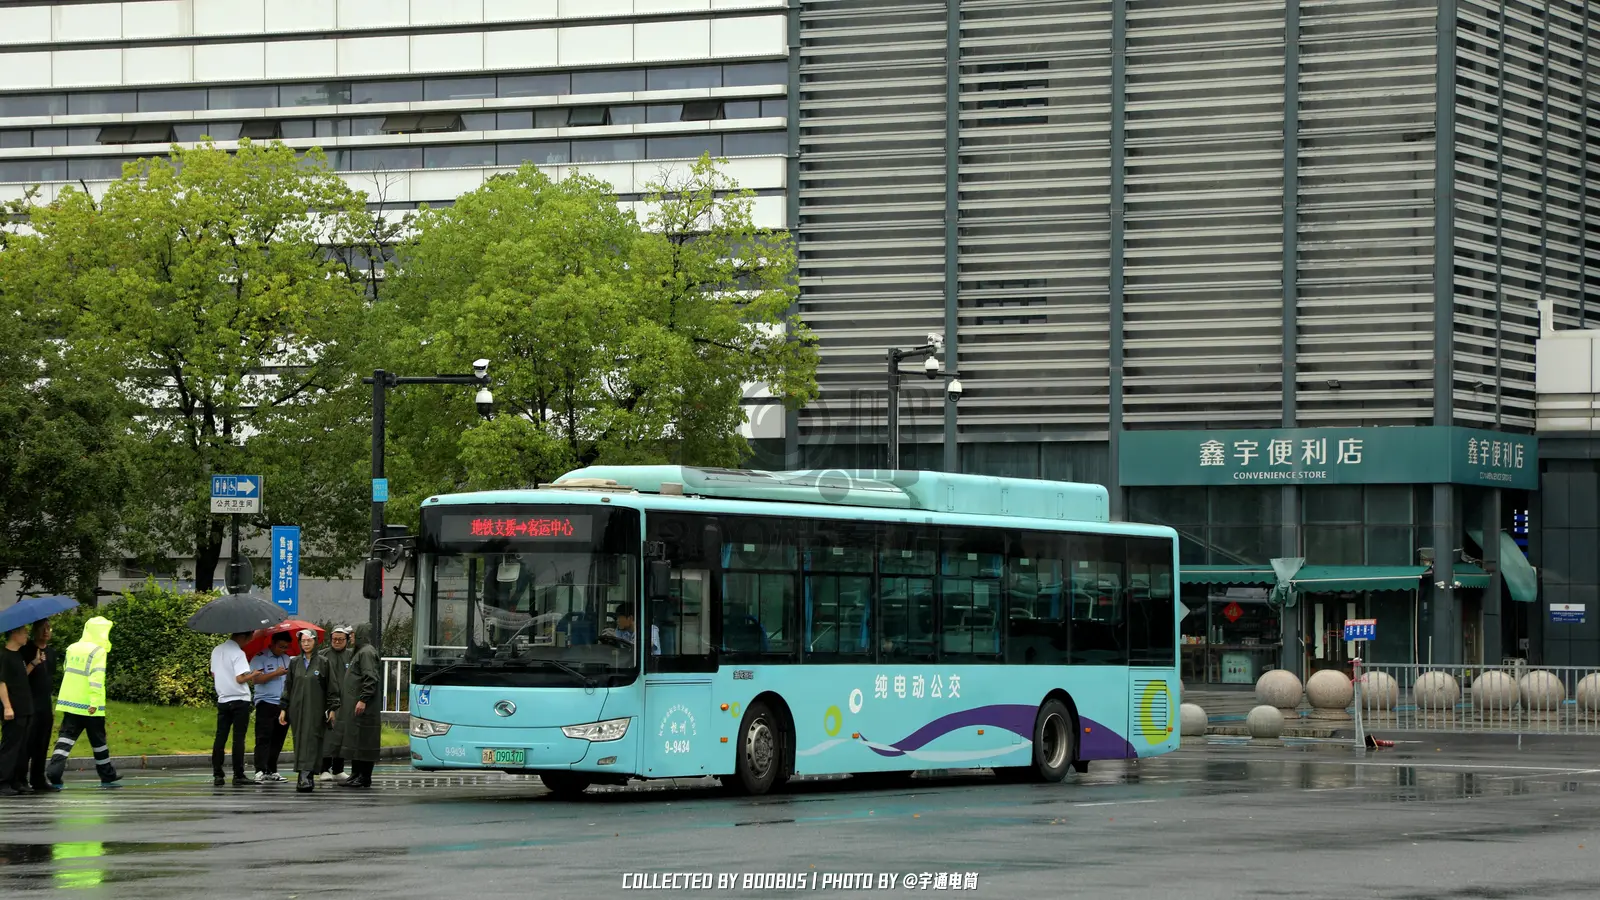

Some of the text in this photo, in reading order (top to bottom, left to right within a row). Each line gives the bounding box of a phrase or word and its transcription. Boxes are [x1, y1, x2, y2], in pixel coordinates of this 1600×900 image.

[1199, 437, 1364, 467] 鑫宇便利店
[1468, 437, 1524, 469] 鑫宇便利店
[1233, 470, 1327, 480] CONVENIENCE STORE
[215, 499, 253, 508] 公共卫生间
[471, 518, 574, 537] 地铁支援 客运中心
[874, 673, 961, 699] 纯电动公交
[445, 746, 466, 757] 9-9434
[665, 740, 690, 754] 9-9434
